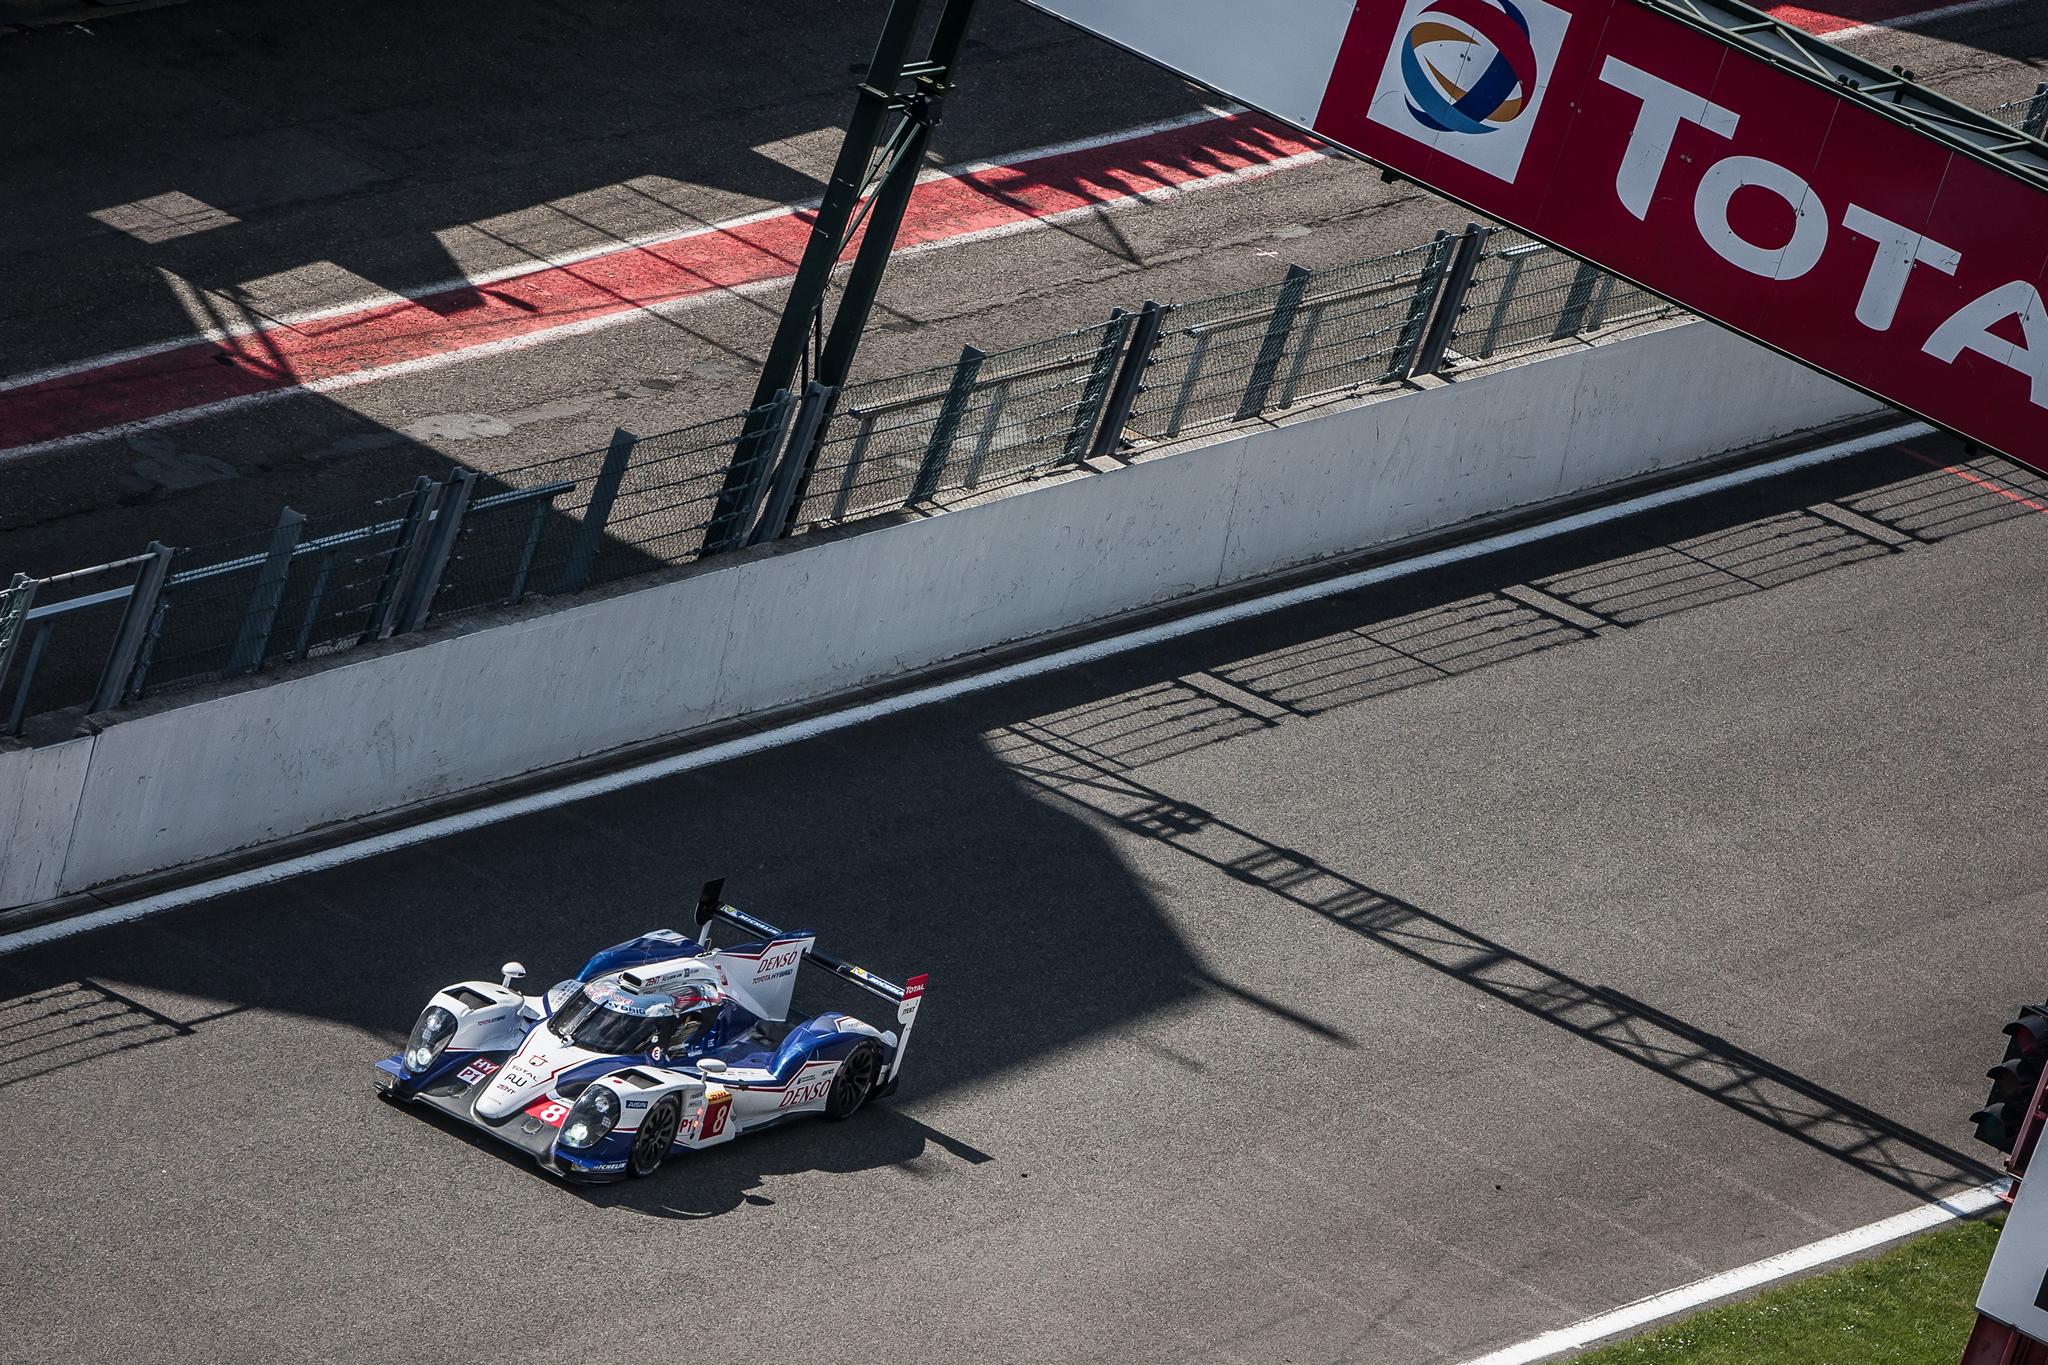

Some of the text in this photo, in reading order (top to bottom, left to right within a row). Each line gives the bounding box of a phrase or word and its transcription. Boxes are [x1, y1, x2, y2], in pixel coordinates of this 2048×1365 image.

[738, 914, 780, 935] MICHELIN
[757, 951, 798, 974] DENSO
[645, 975, 661, 987] ZENT
[752, 968, 794, 985] TOYOTA HYBRID
[905, 983, 925, 995] TOTAL
[472, 1058, 496, 1073] HY
[460, 1068, 481, 1083] P1
[511, 1064, 539, 1083] TOTAL
[496, 1083, 517, 1096] ZENT
[711, 1090, 728, 1101] DHL
[778, 1079, 832, 1108] DENSO
[627, 1101, 648, 1109] AISIN
[540, 1103, 567, 1123] 8
[712, 1105, 728, 1134] 8
[679, 1118, 695, 1134] P1
[592, 1162, 627, 1171] MICHELIN
